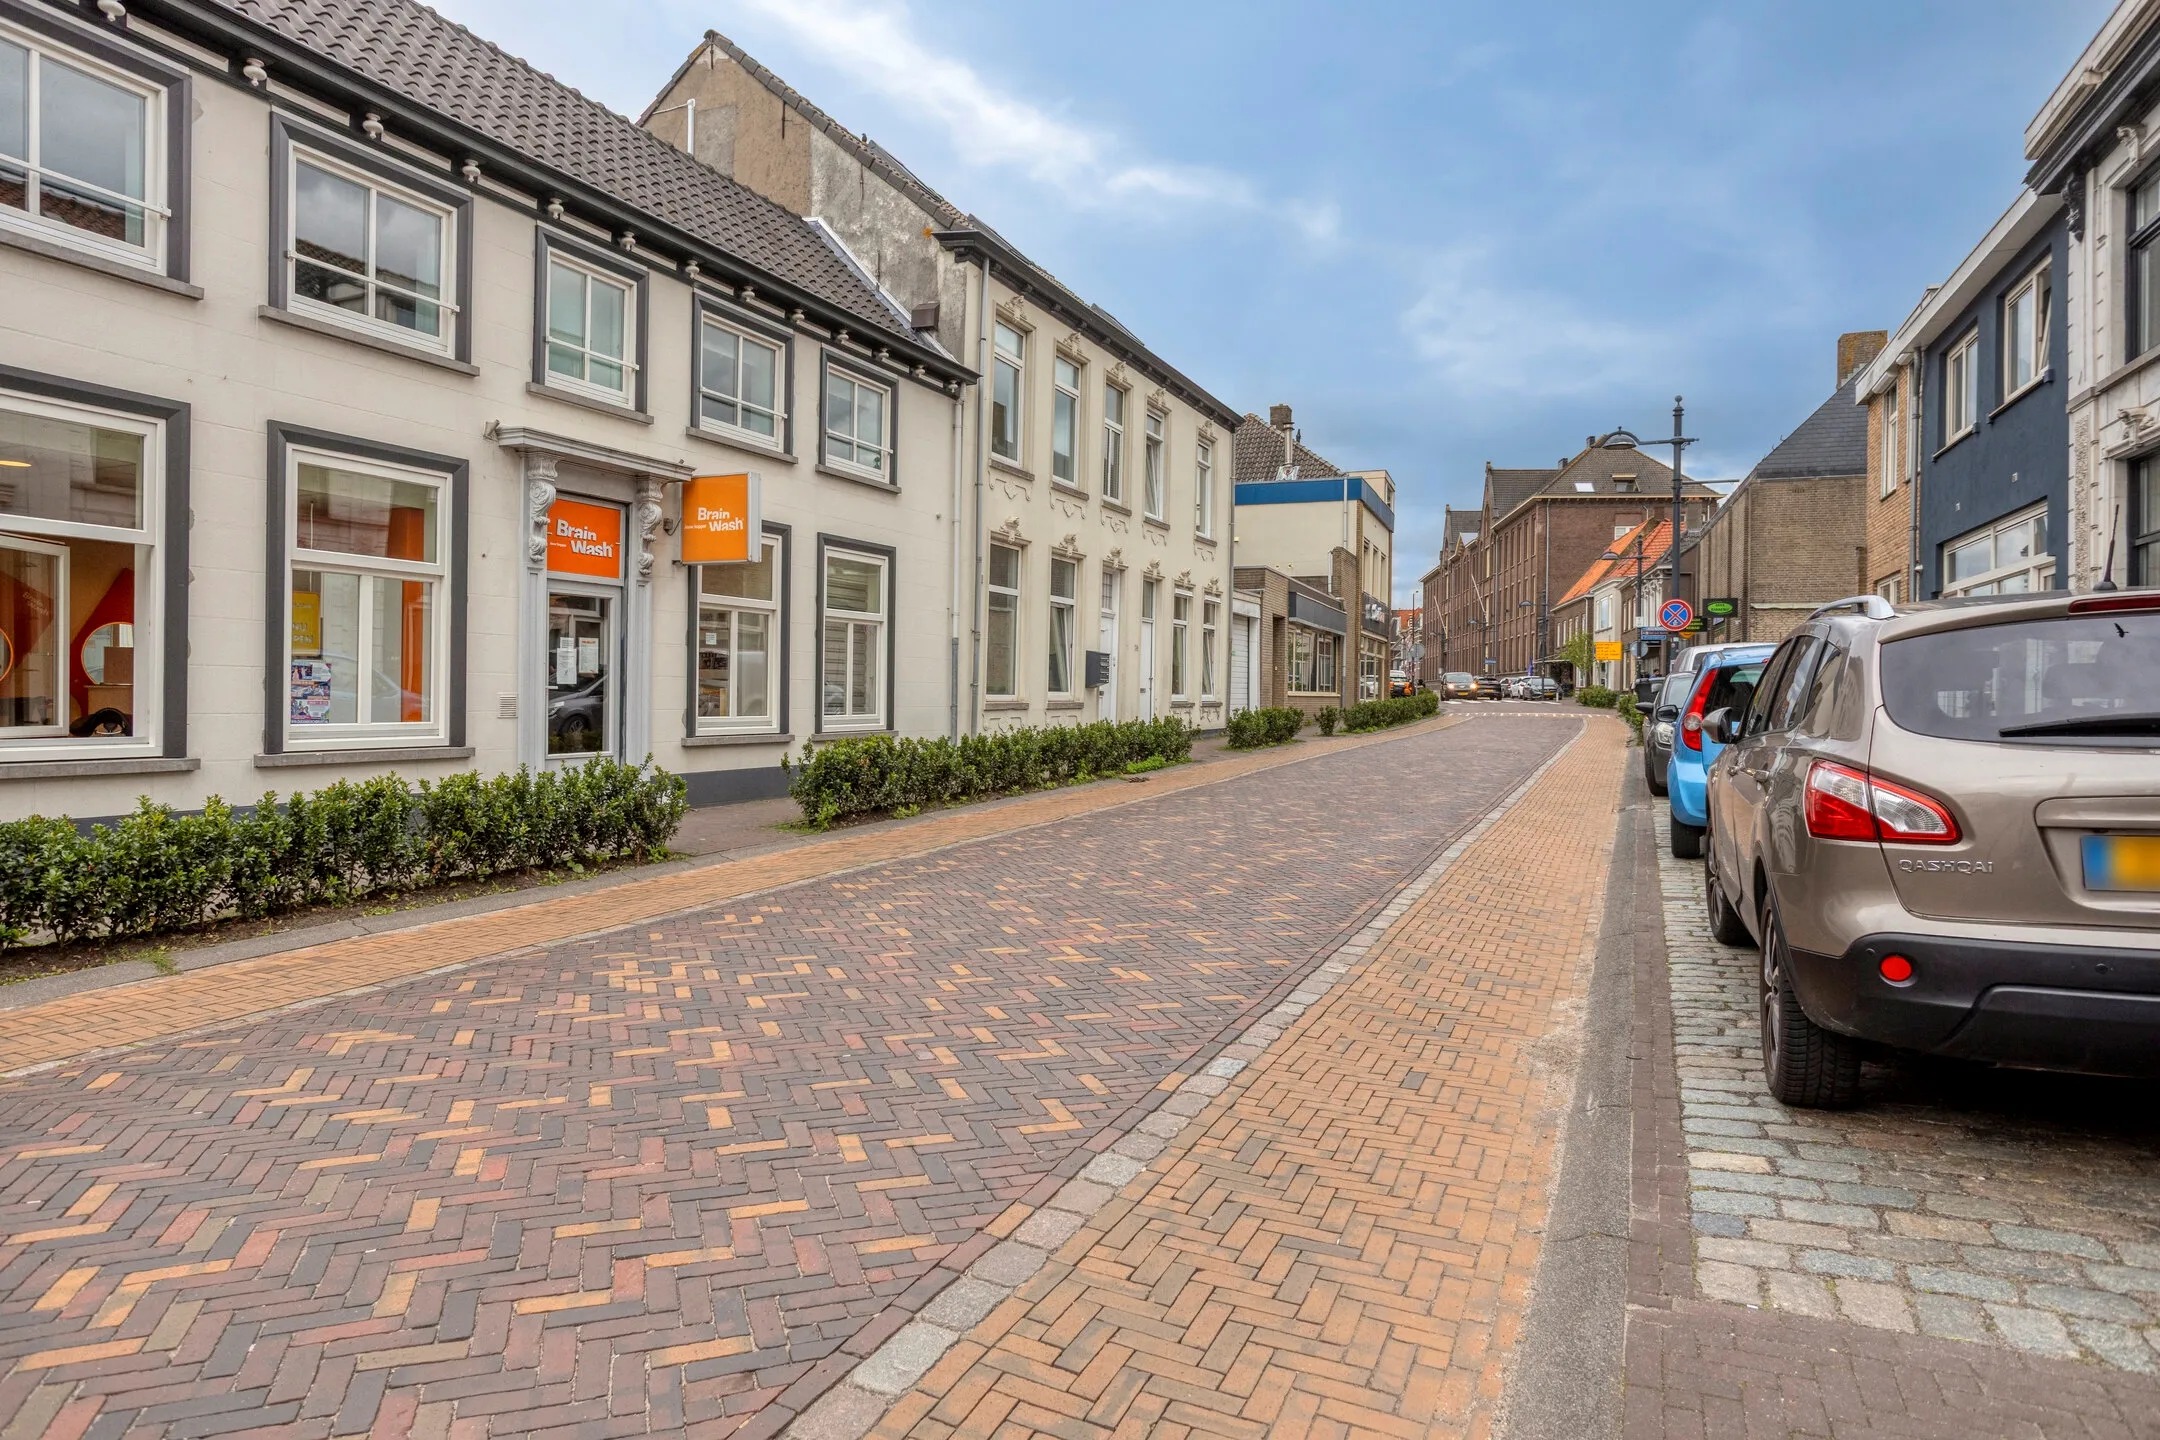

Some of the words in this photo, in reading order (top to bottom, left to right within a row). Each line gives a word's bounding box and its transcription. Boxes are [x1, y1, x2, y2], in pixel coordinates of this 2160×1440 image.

[697, 507, 730, 520] Brain
[556, 518, 597, 541] Brain
[708, 516, 744, 531] Wash
[570, 539, 613, 558] Wash
